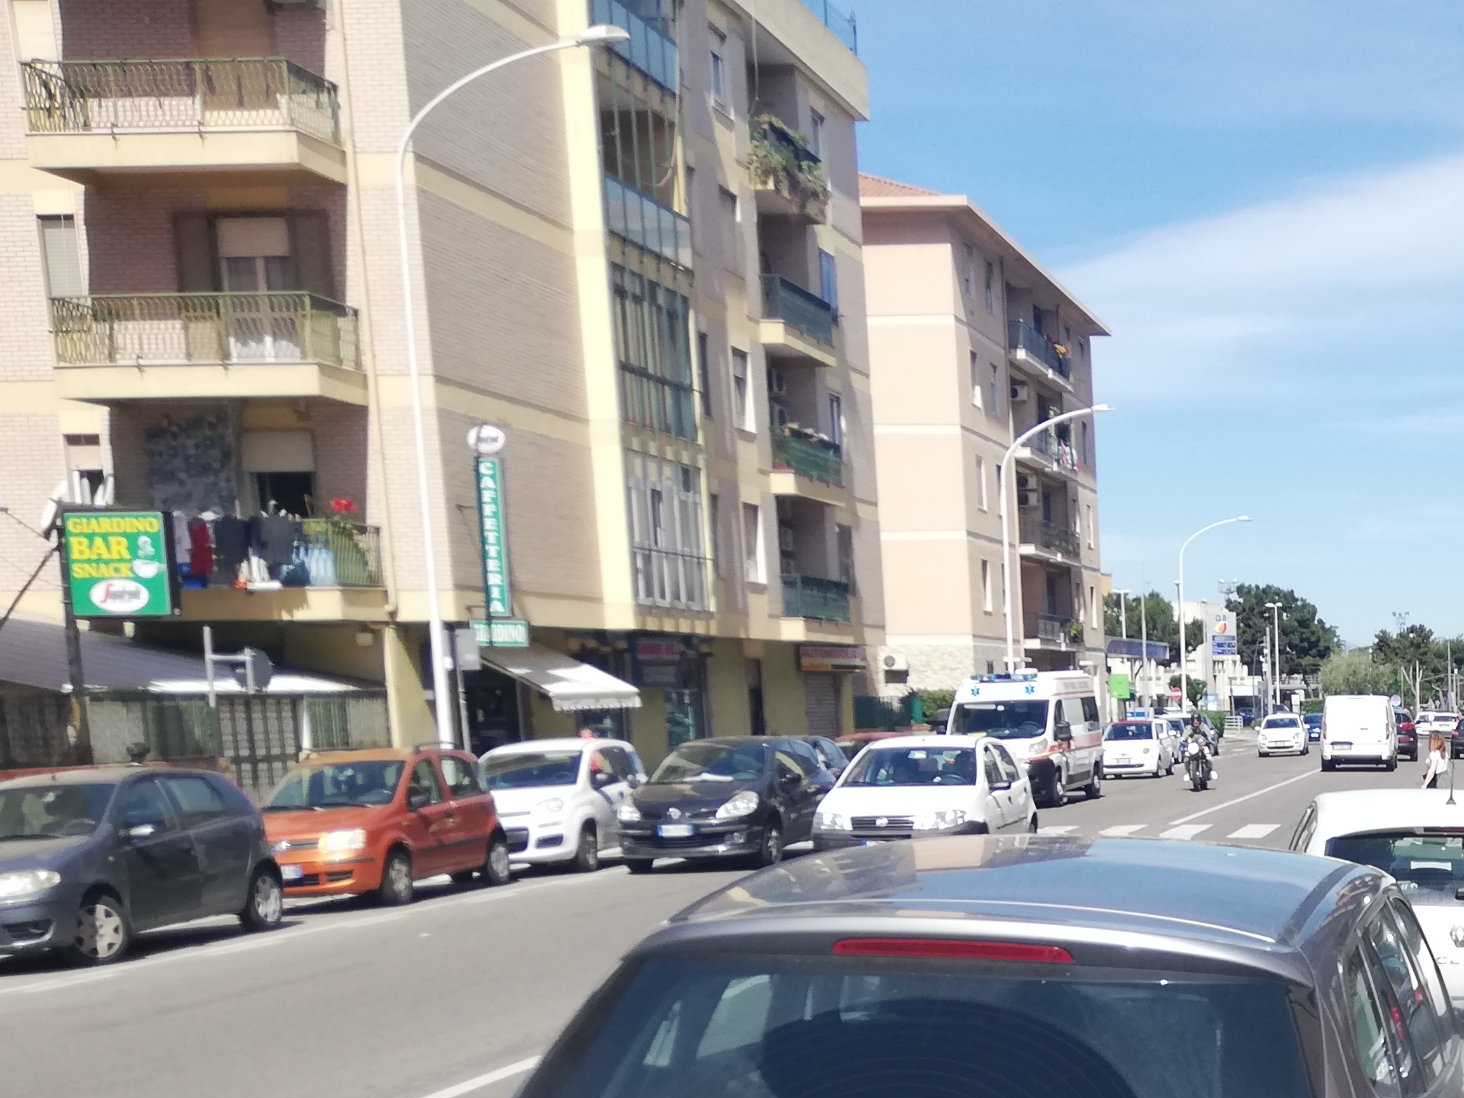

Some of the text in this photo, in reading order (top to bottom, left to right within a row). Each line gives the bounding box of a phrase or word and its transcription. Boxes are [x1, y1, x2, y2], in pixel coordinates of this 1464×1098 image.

[67, 517, 160, 533] GIARDINO
[479, 462, 505, 612] CAFFETTERIA
[69, 536, 132, 560] BAR
[71, 563, 135, 578] SNACK
